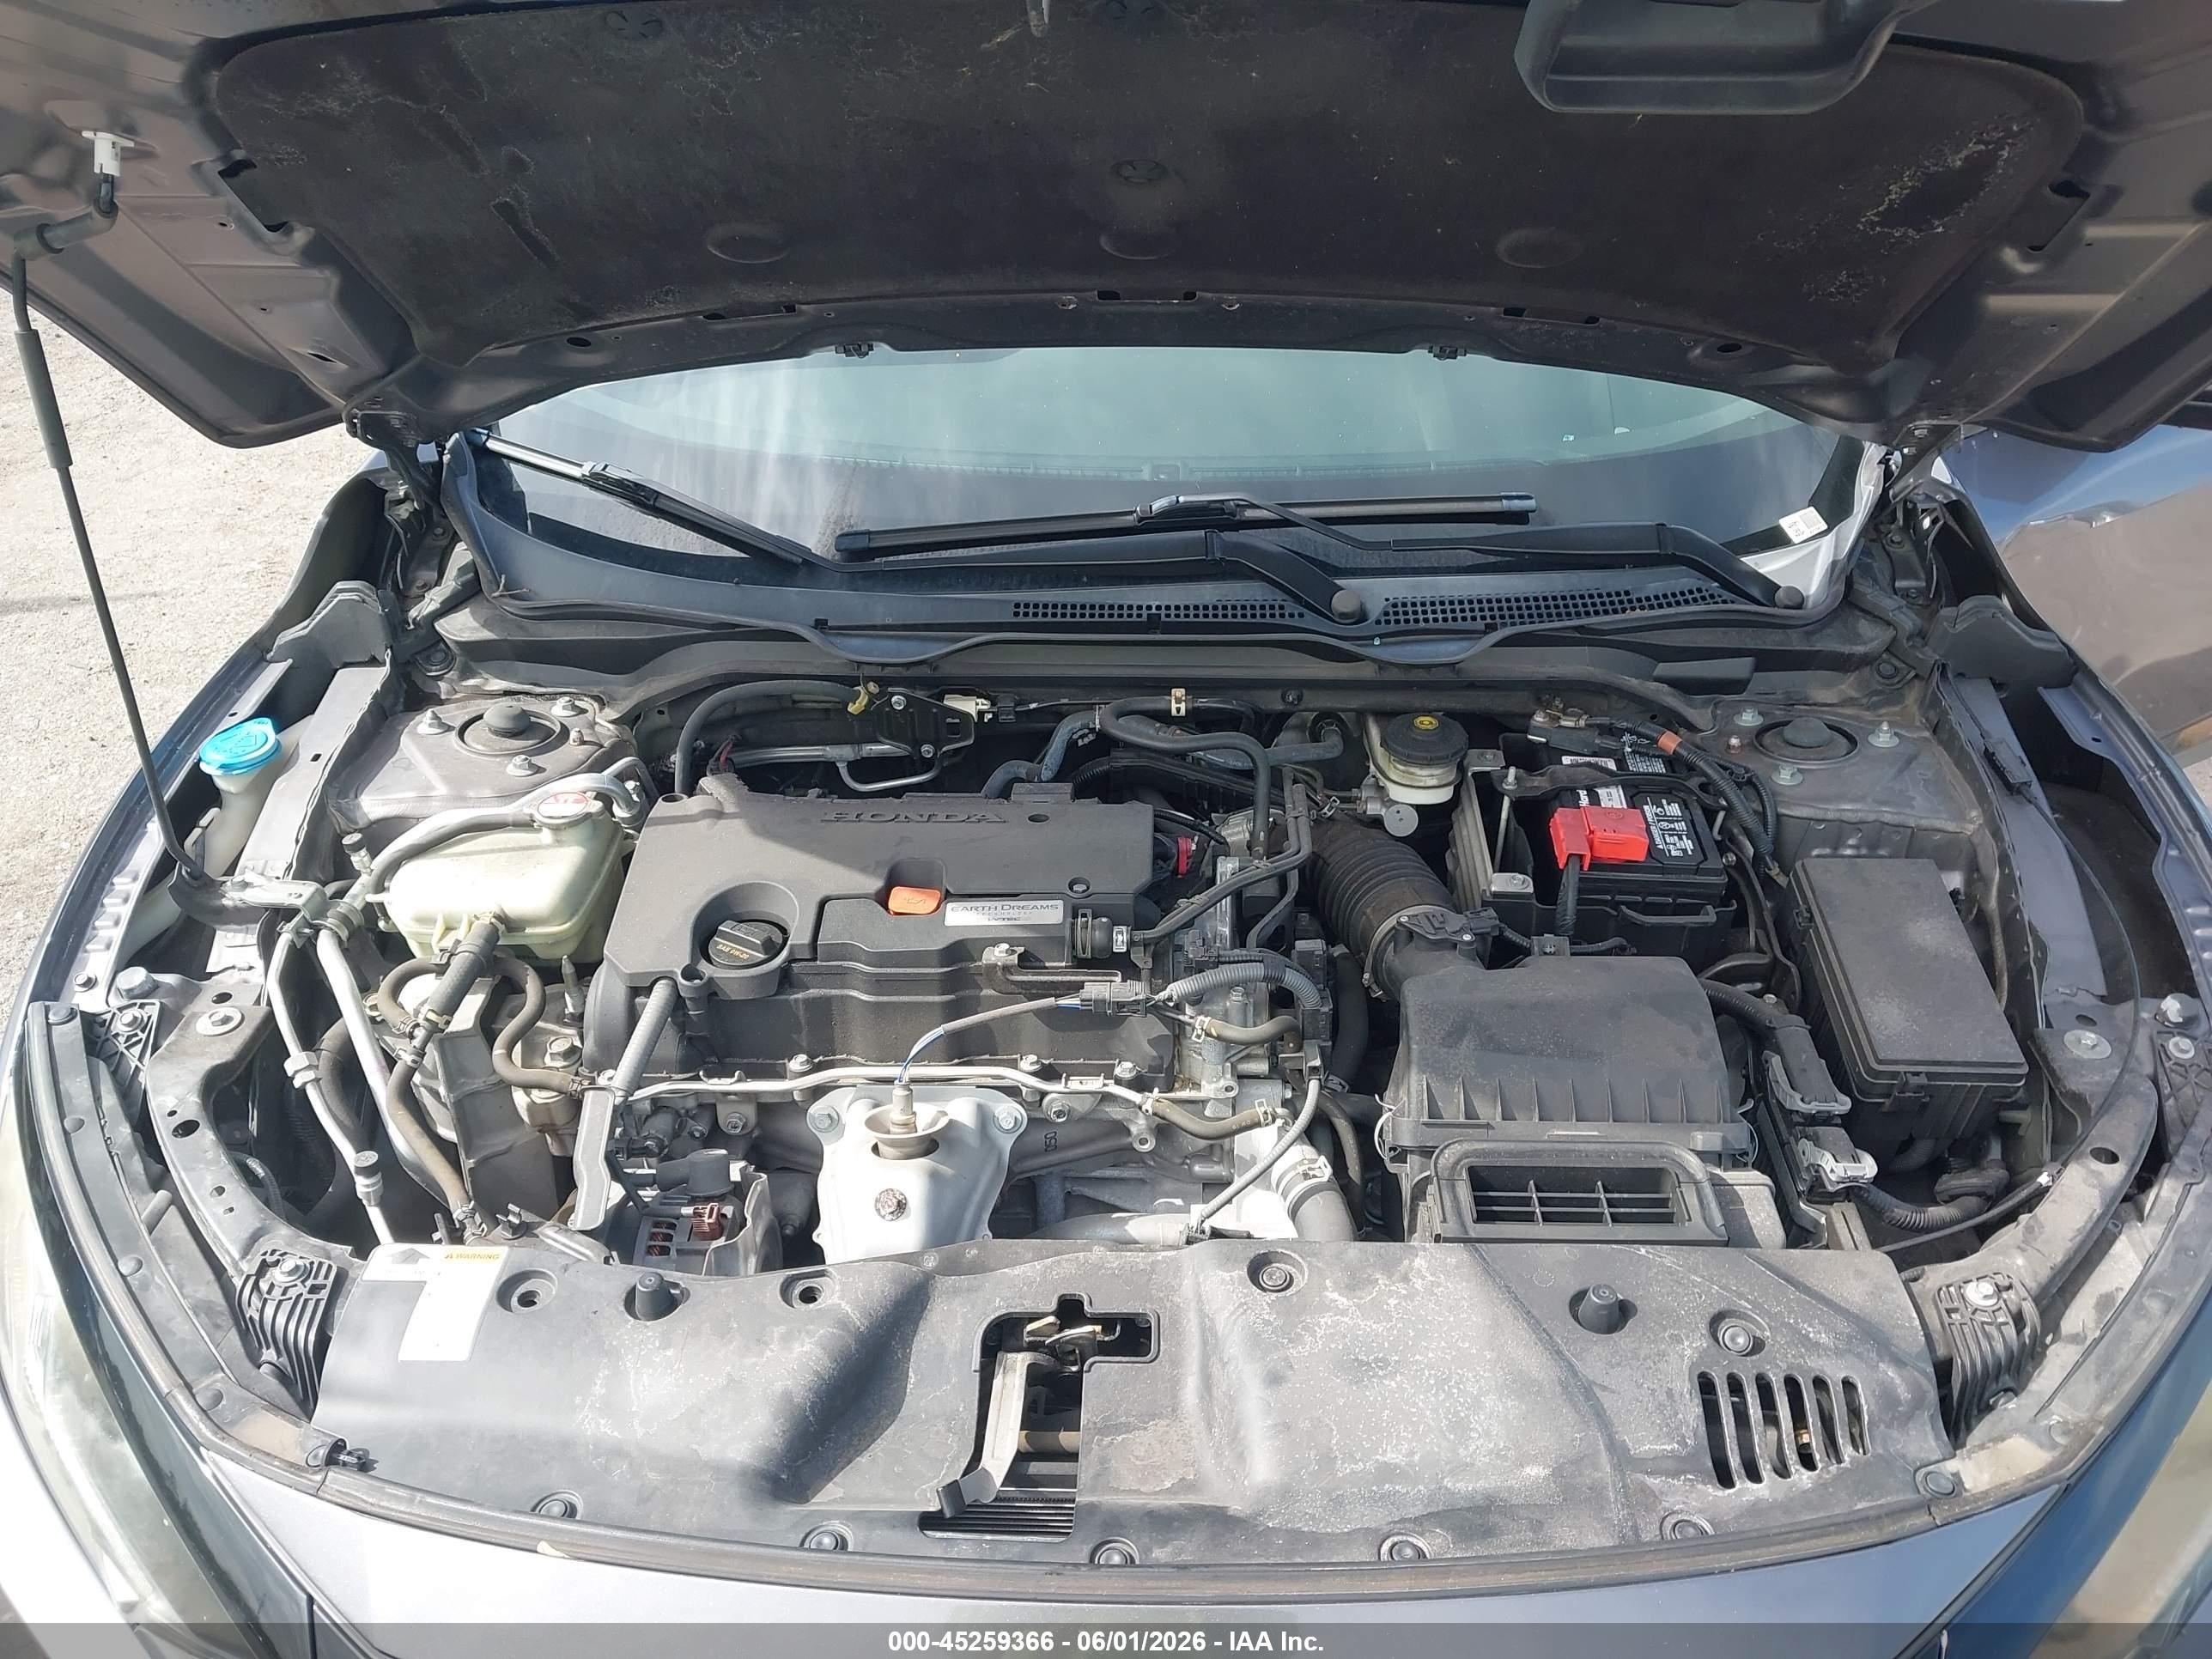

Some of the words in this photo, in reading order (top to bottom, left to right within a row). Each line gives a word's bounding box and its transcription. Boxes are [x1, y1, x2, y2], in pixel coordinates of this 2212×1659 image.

[821, 812, 1010, 823] HONDA
[1650, 825, 1662, 844] DANGER
[1001, 903, 1059, 912] DREAMS
